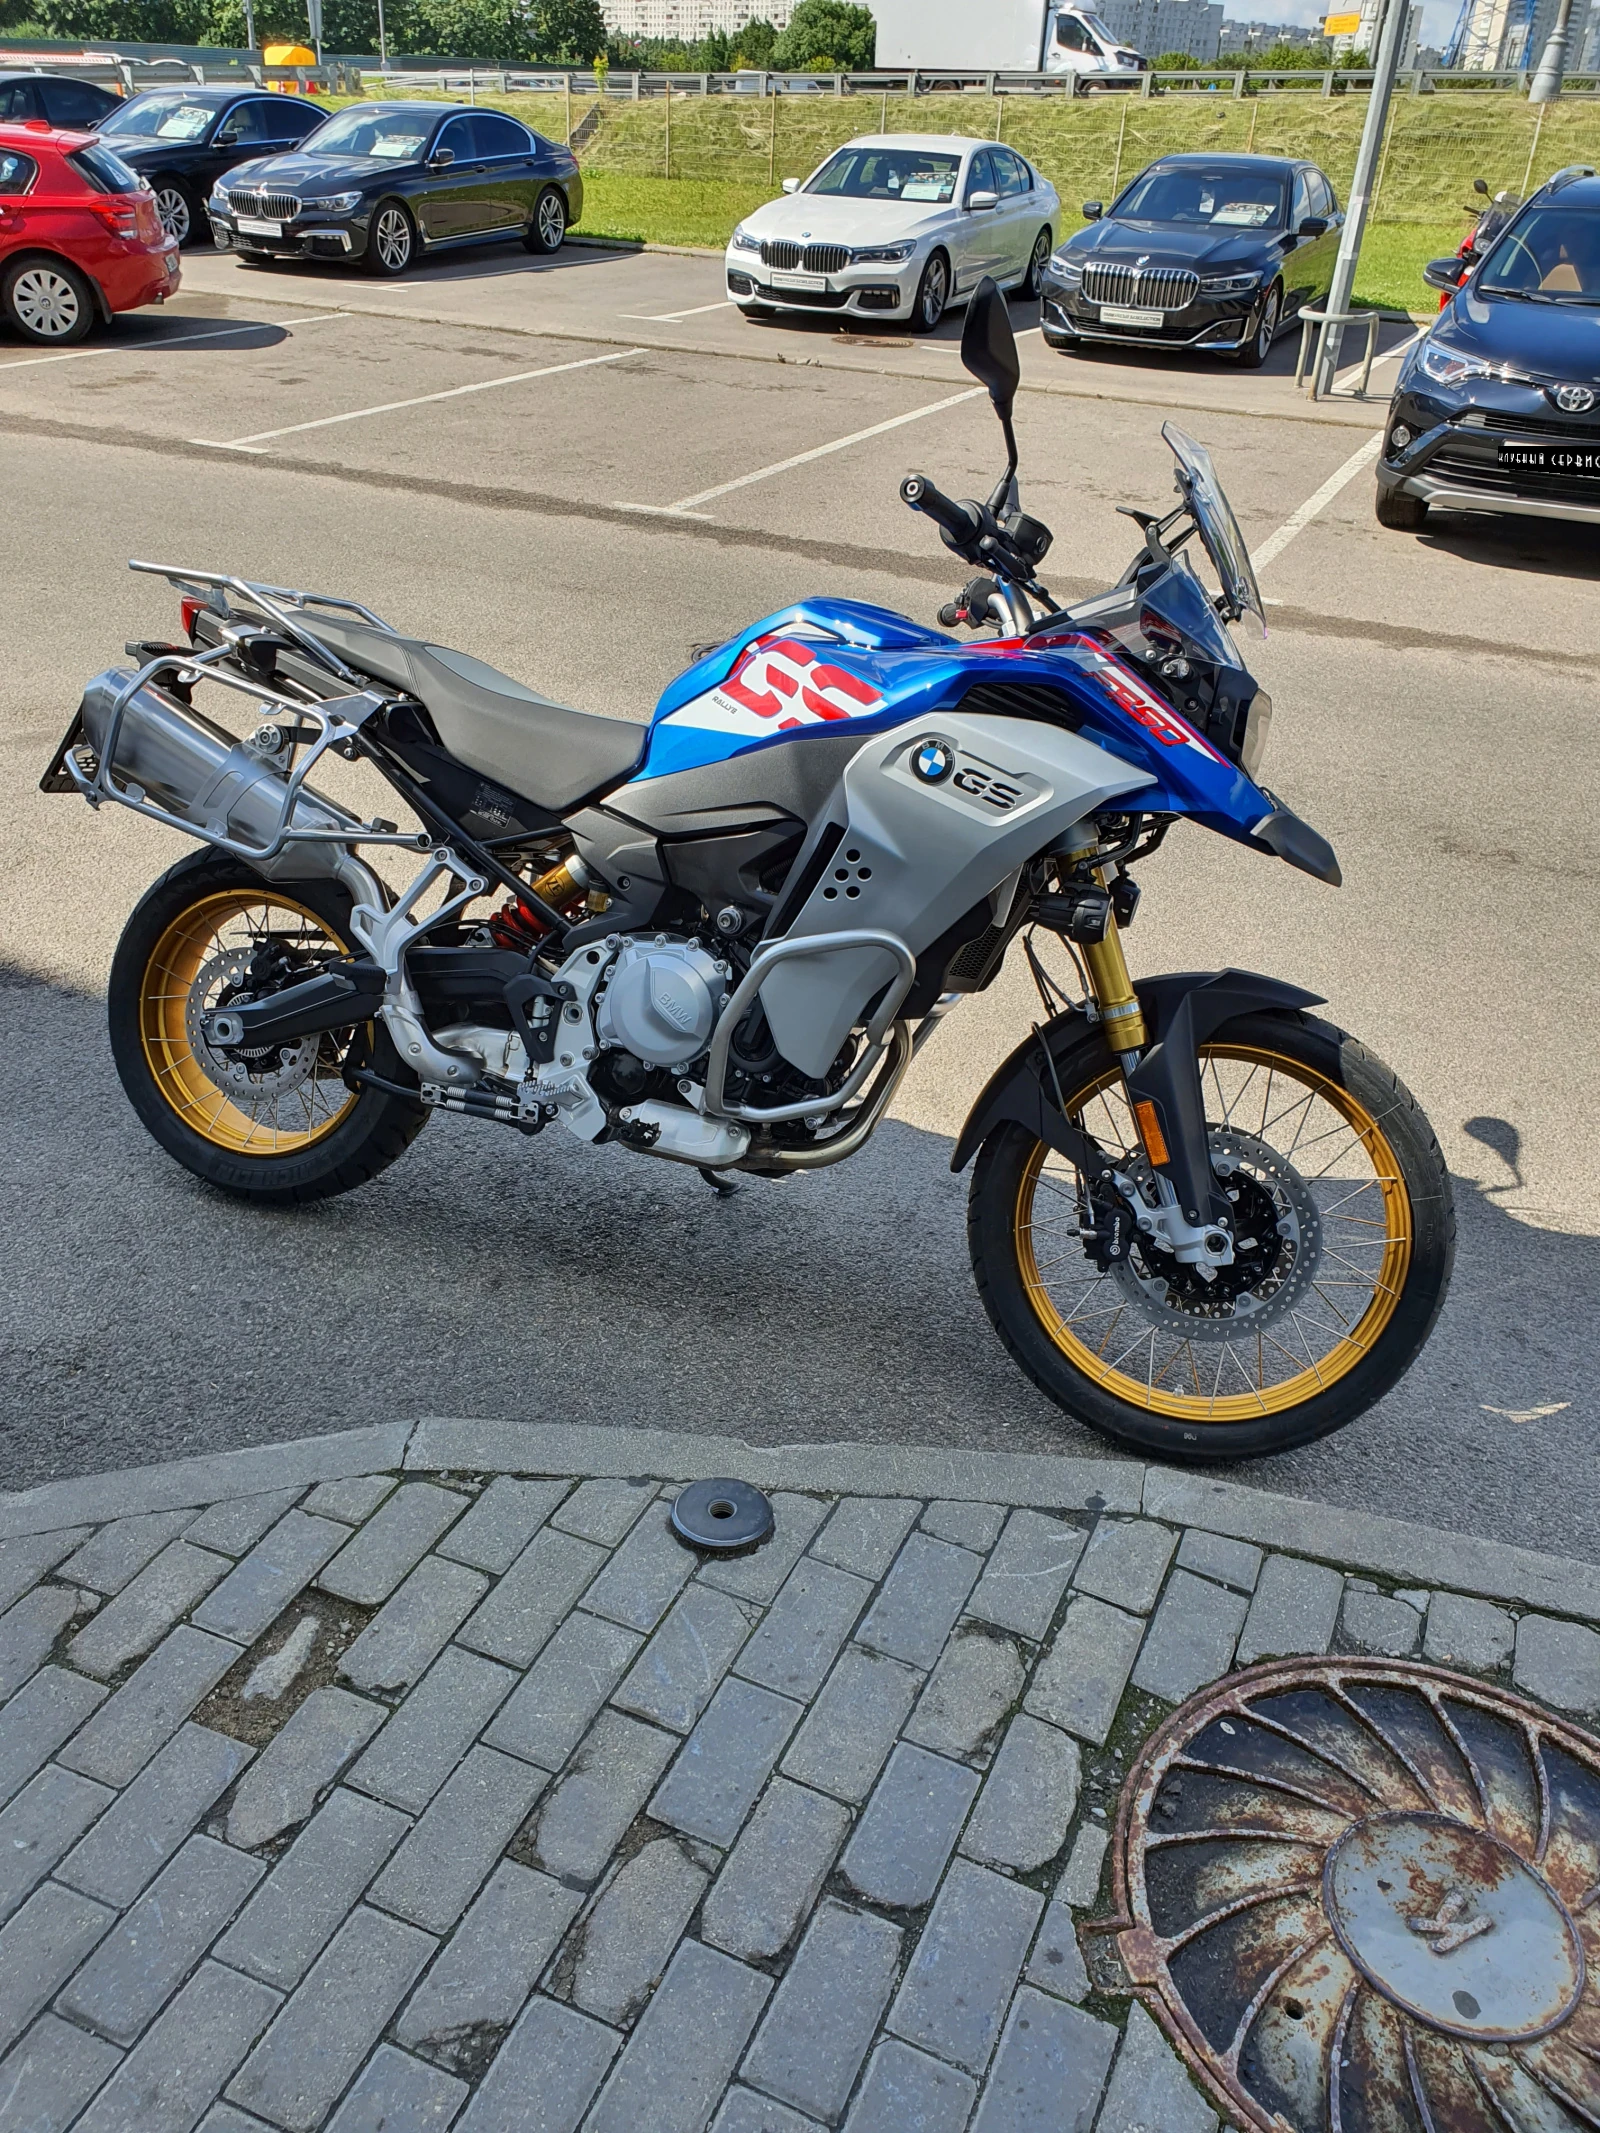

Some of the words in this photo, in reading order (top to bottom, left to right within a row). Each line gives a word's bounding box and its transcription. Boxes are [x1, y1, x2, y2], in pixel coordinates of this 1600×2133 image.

[921, 741, 954, 761] BMW
[953, 767, 1024, 810] GS
[659, 991, 692, 1024] BMW
[1111, 1216, 1120, 1245] brembo
